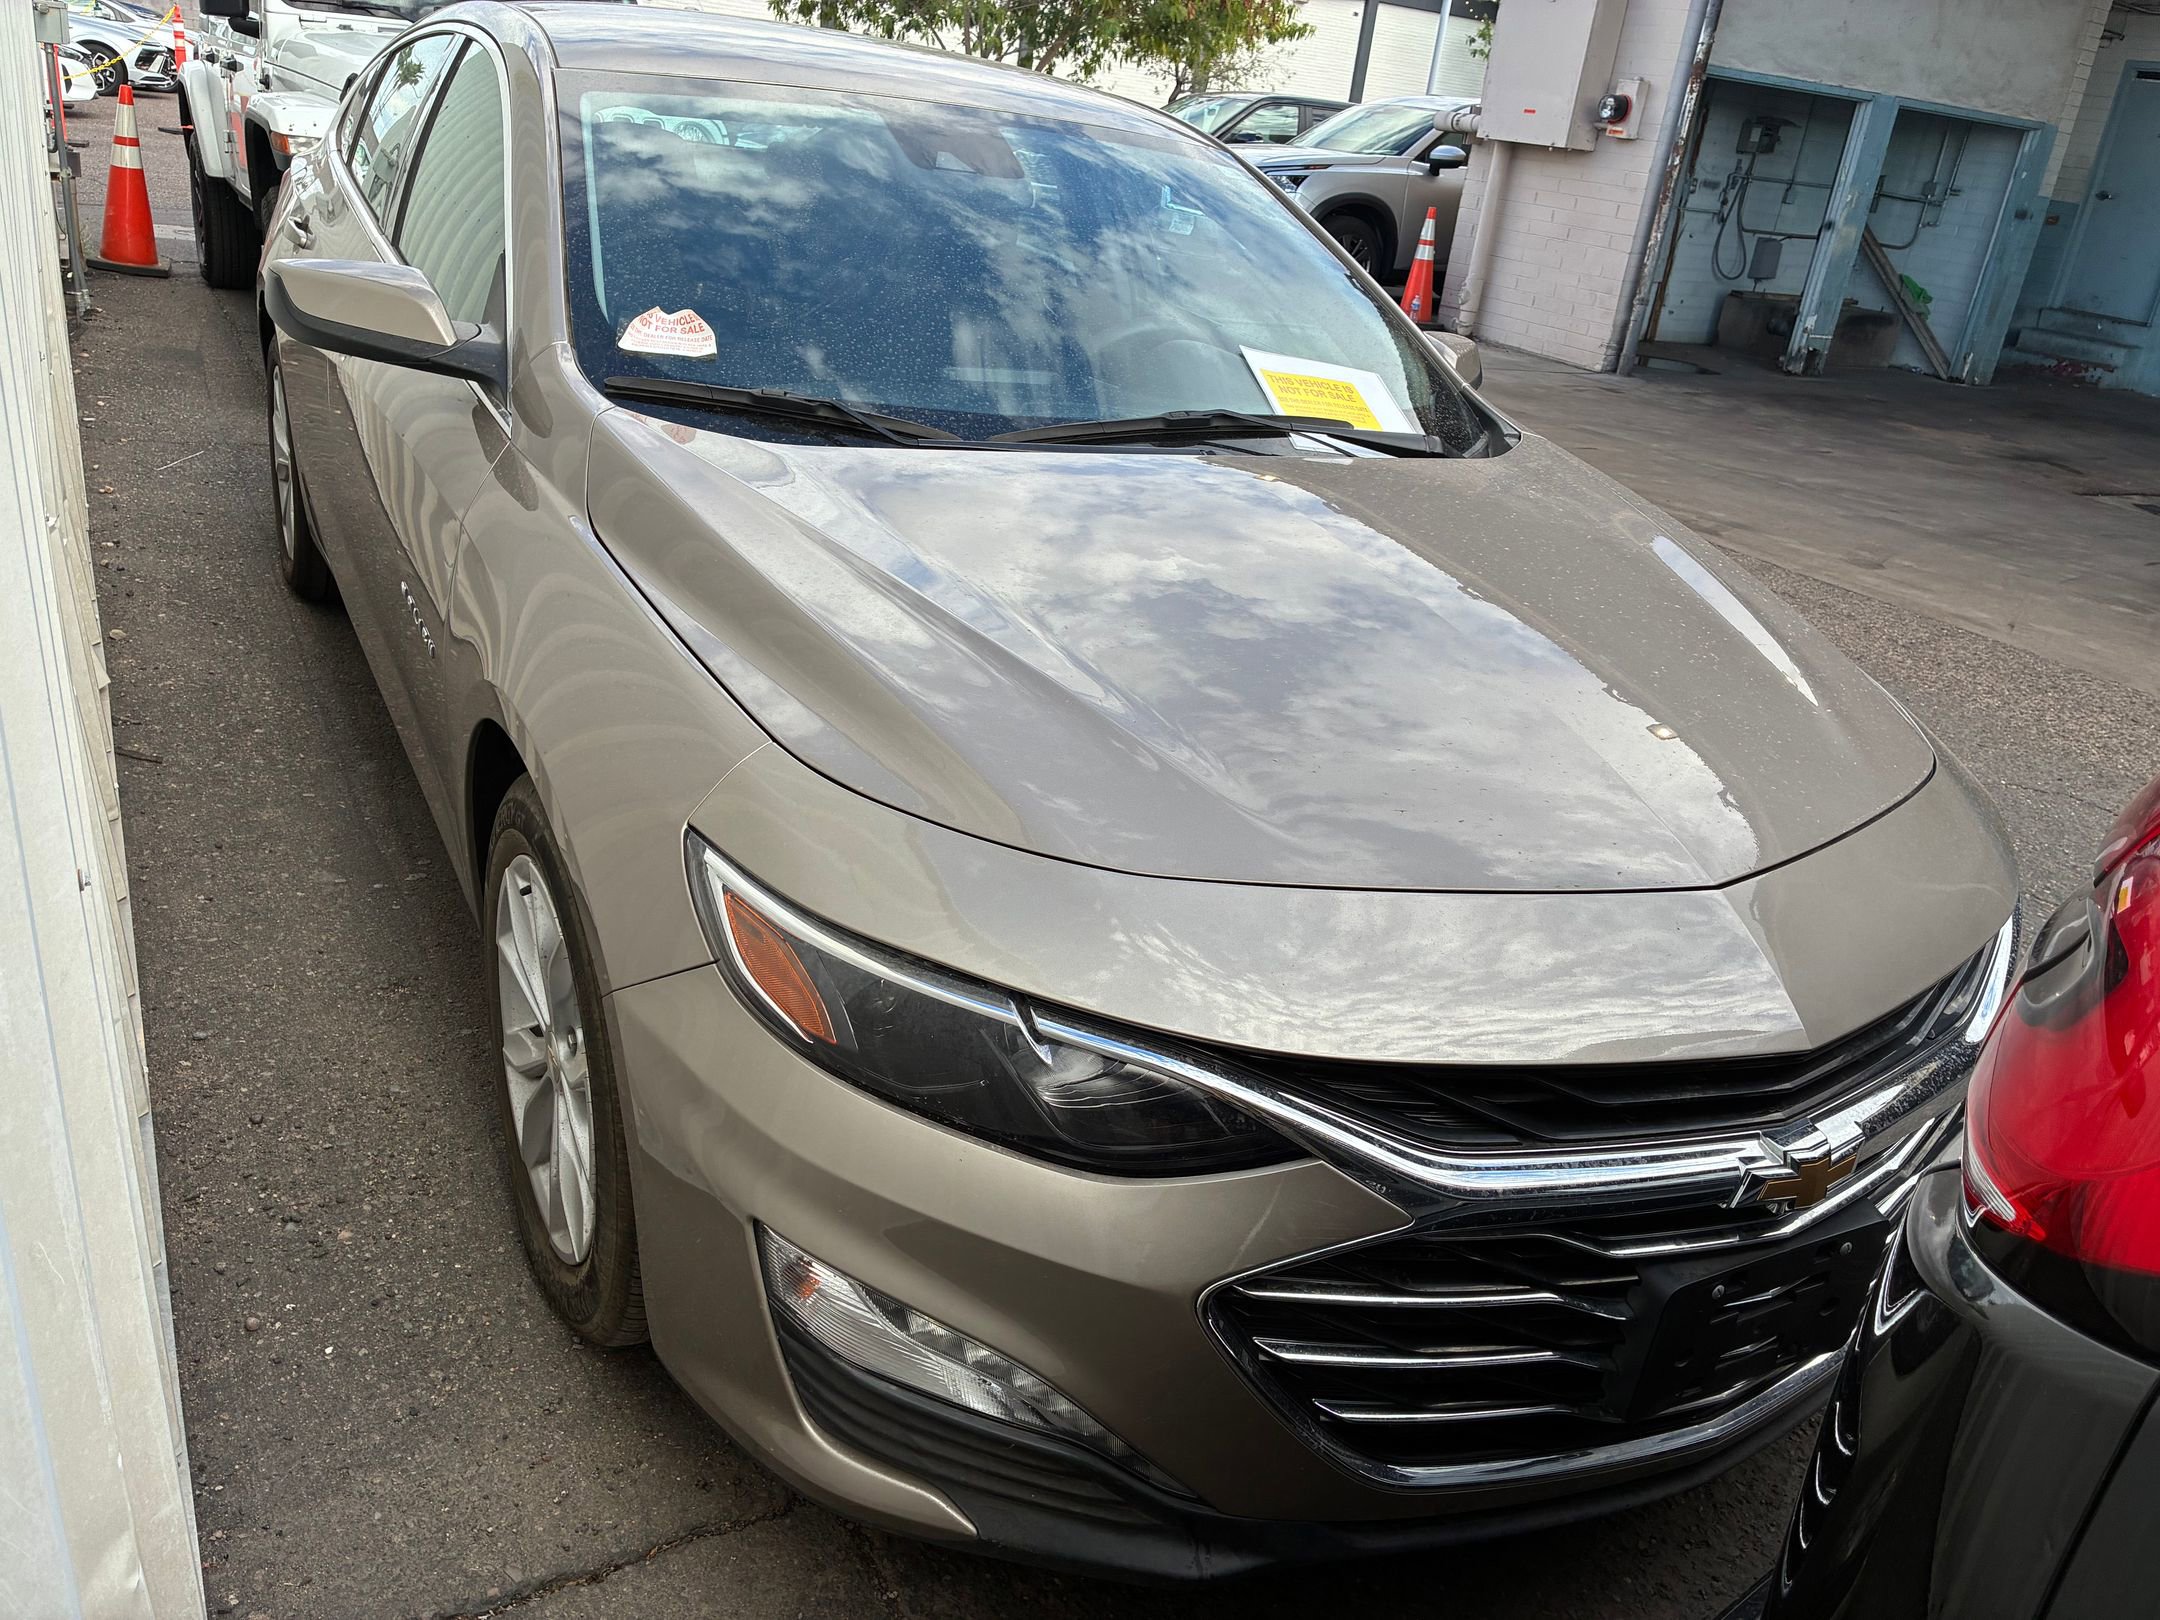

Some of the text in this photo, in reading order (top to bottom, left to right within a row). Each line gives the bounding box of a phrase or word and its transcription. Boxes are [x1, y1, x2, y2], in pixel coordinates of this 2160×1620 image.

[655, 313, 696, 326] VEHICLE
[655, 325, 678, 334] FOR
[680, 322, 705, 335] SALE
[1267, 374, 1355, 394] THIS VEHICLE IS
[1278, 385, 1357, 403] NOT FOR SALE
